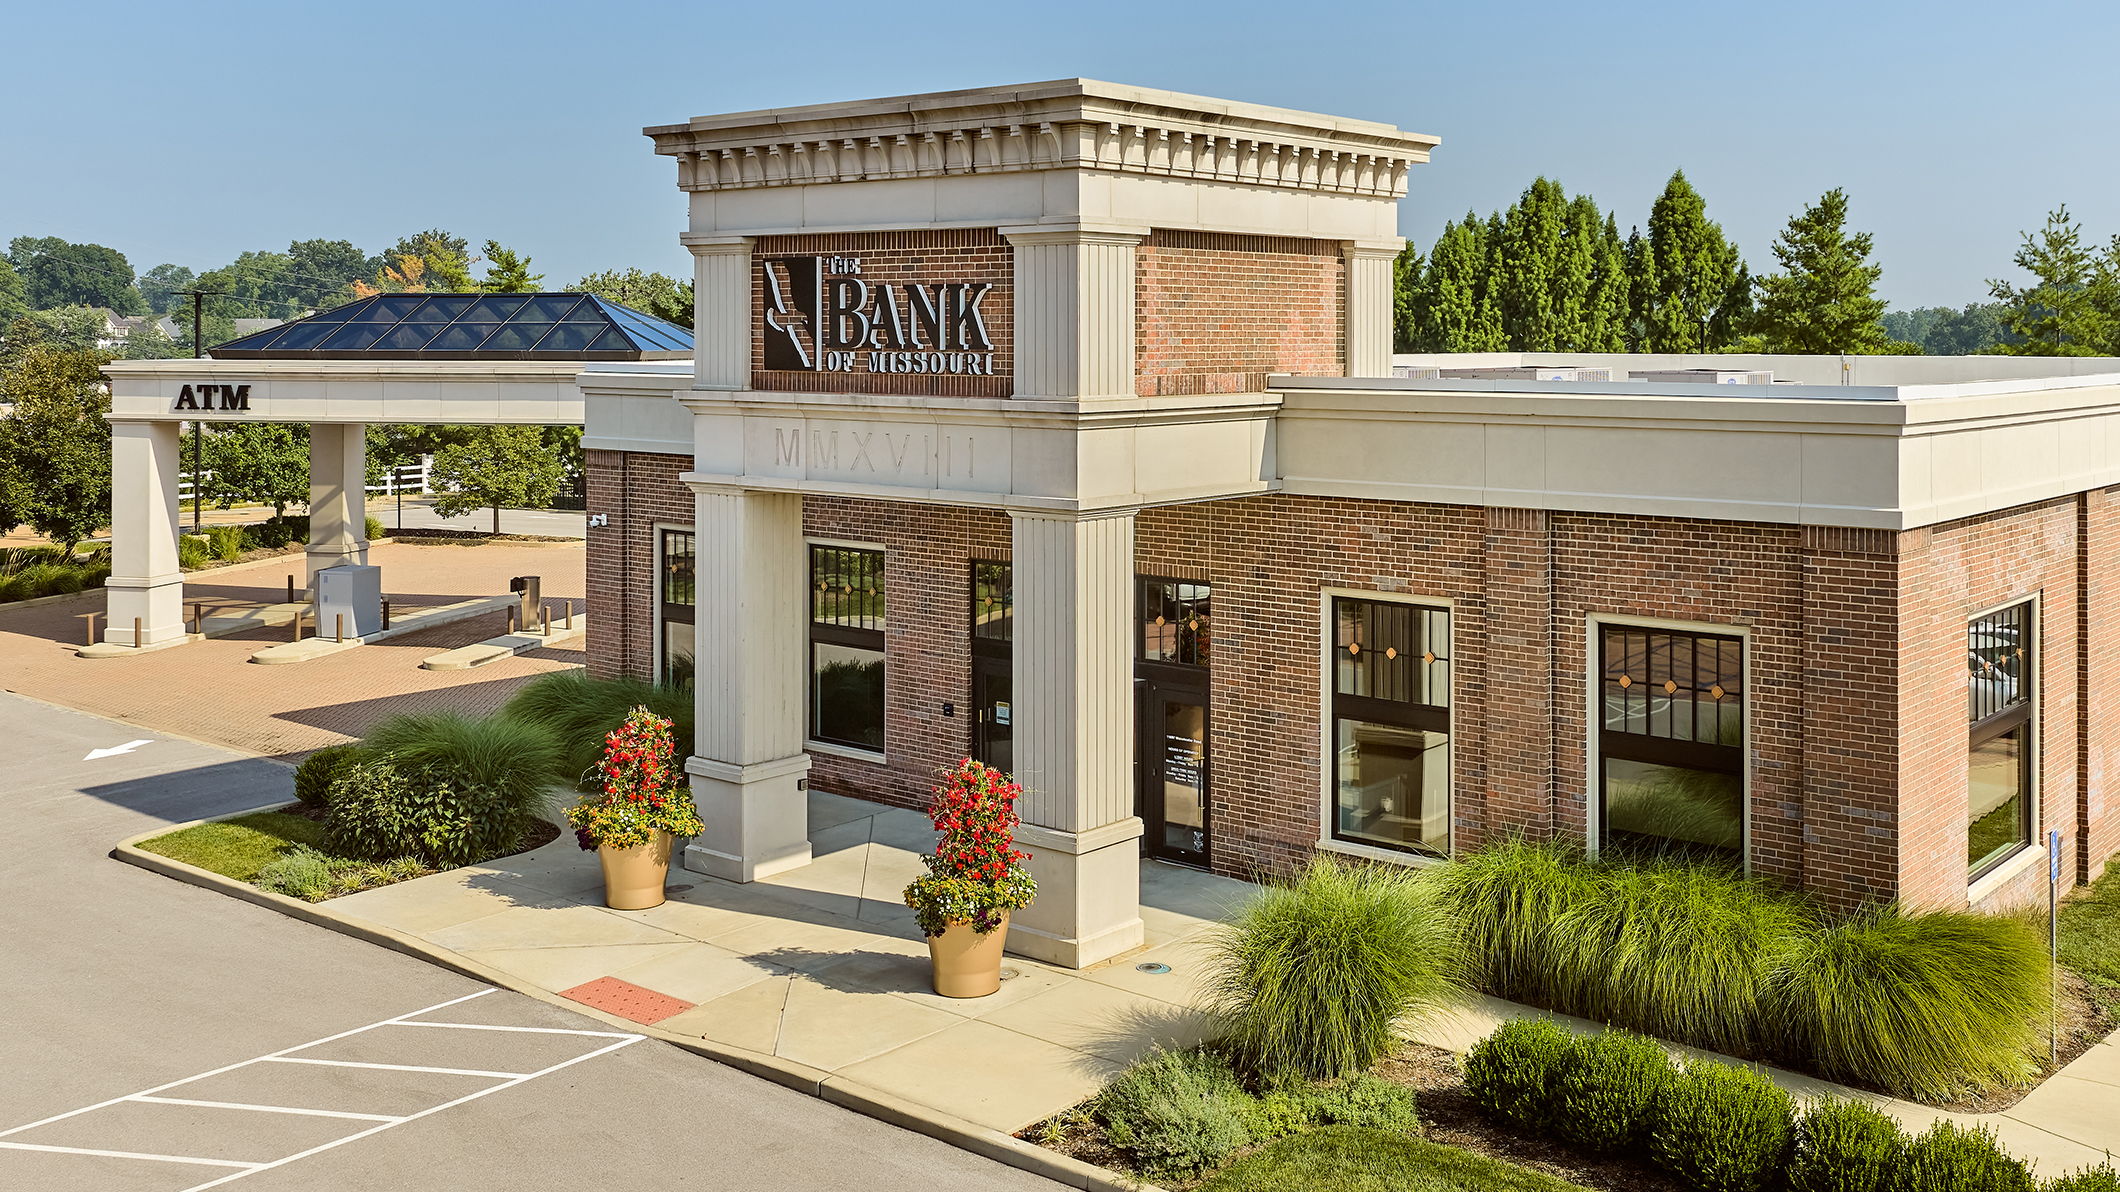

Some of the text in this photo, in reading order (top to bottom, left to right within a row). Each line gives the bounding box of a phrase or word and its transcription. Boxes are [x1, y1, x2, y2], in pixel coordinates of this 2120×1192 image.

[825, 256, 861, 274] THE
[825, 278, 994, 350] BANK
[826, 351, 994, 375] OF MISSOURI
[174, 384, 251, 411] ATM
[775, 427, 974, 478] MMXVIII
